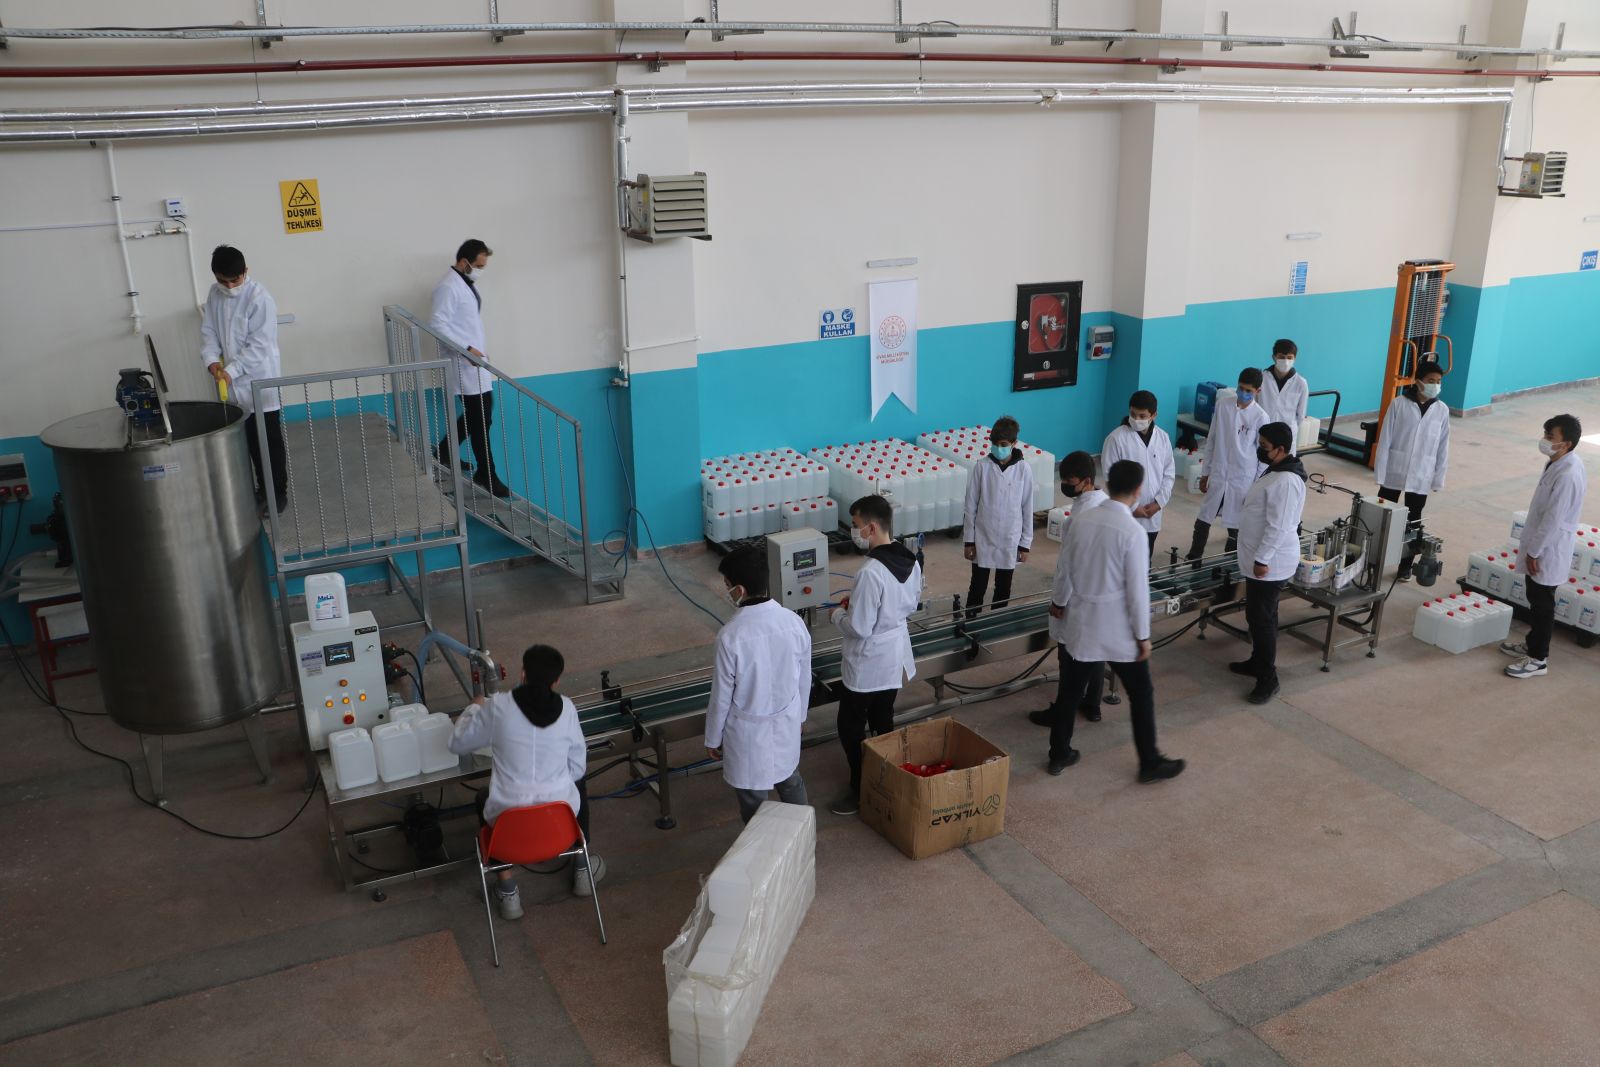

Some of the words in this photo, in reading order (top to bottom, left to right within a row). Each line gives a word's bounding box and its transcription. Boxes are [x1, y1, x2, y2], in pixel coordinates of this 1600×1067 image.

[287, 208, 317, 218] DÜŞME
[286, 218, 321, 229] TEHLİKESİ
[825, 323, 851, 331] MASKE
[823, 329, 853, 338] KULLAN
[931, 808, 981, 826] YILKAP
